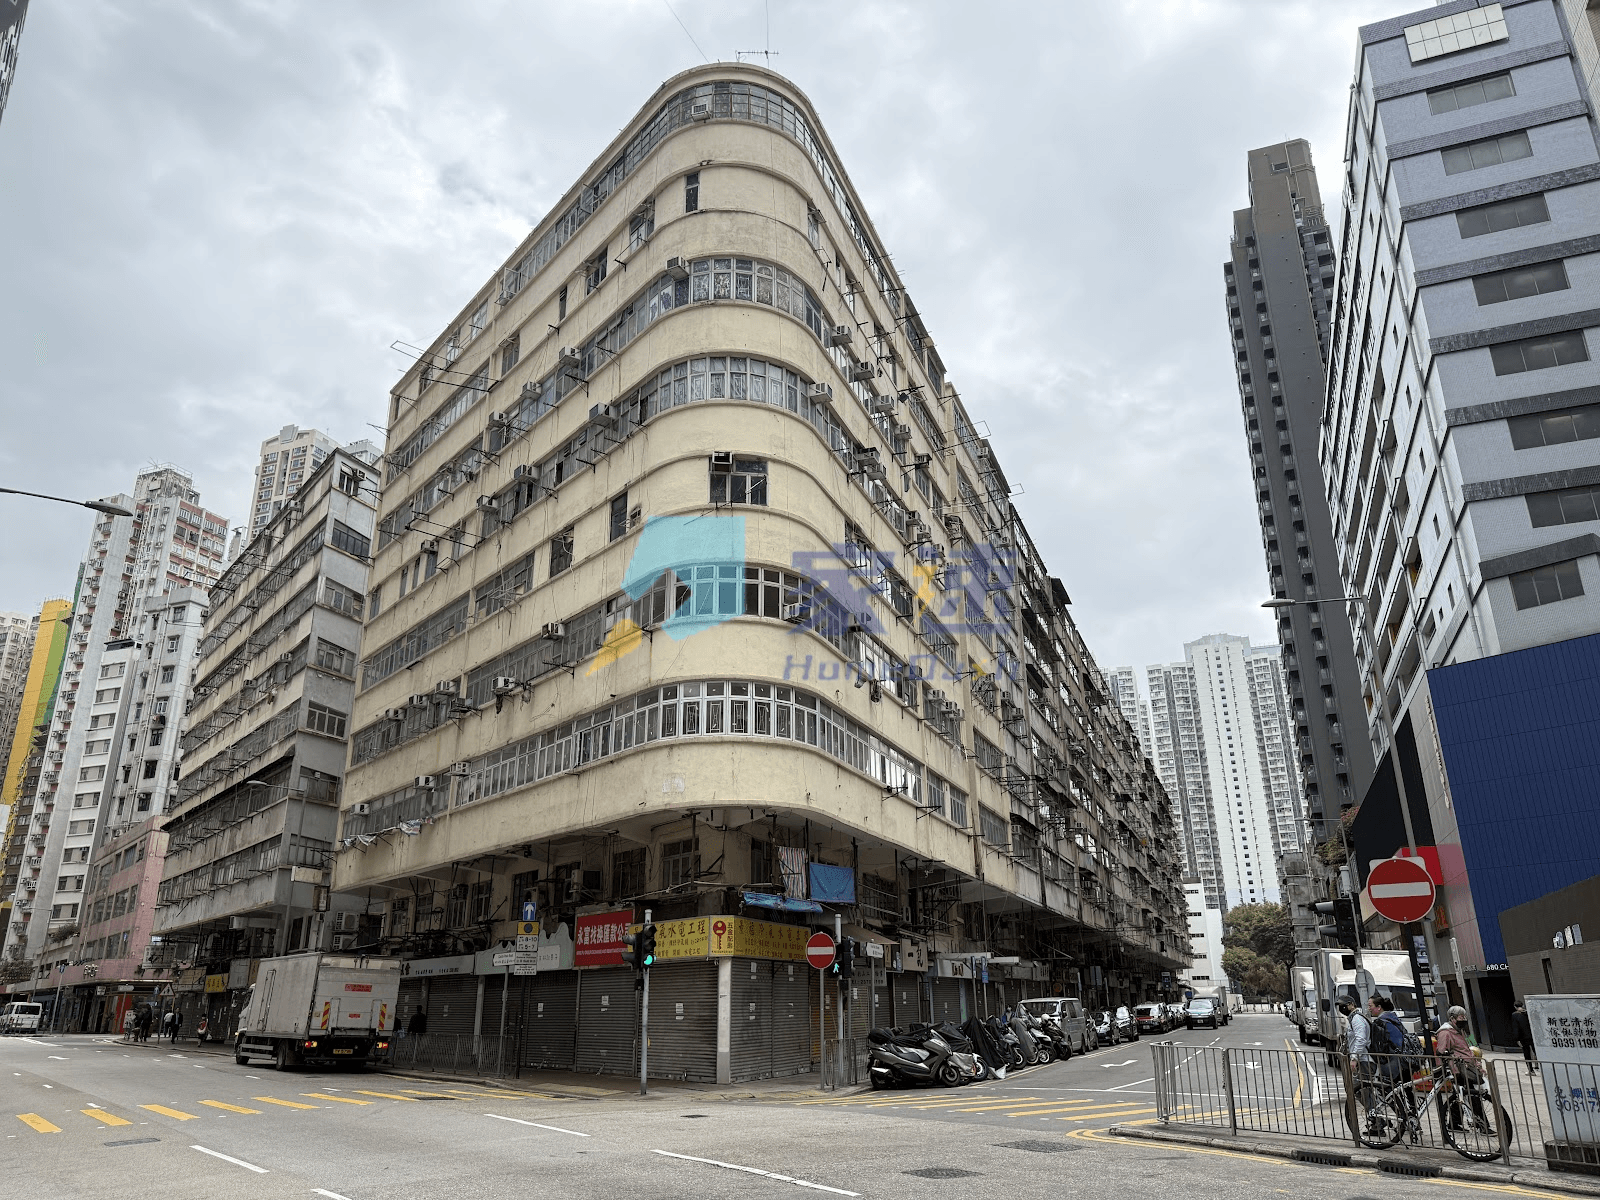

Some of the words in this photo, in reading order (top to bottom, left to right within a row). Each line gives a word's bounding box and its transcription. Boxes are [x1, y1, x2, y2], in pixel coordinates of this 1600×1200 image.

[1486, 963, 1499, 971] 680
[1551, 1037, 1575, 1048] 9039
[1578, 1038, 1599, 1048] 1190
